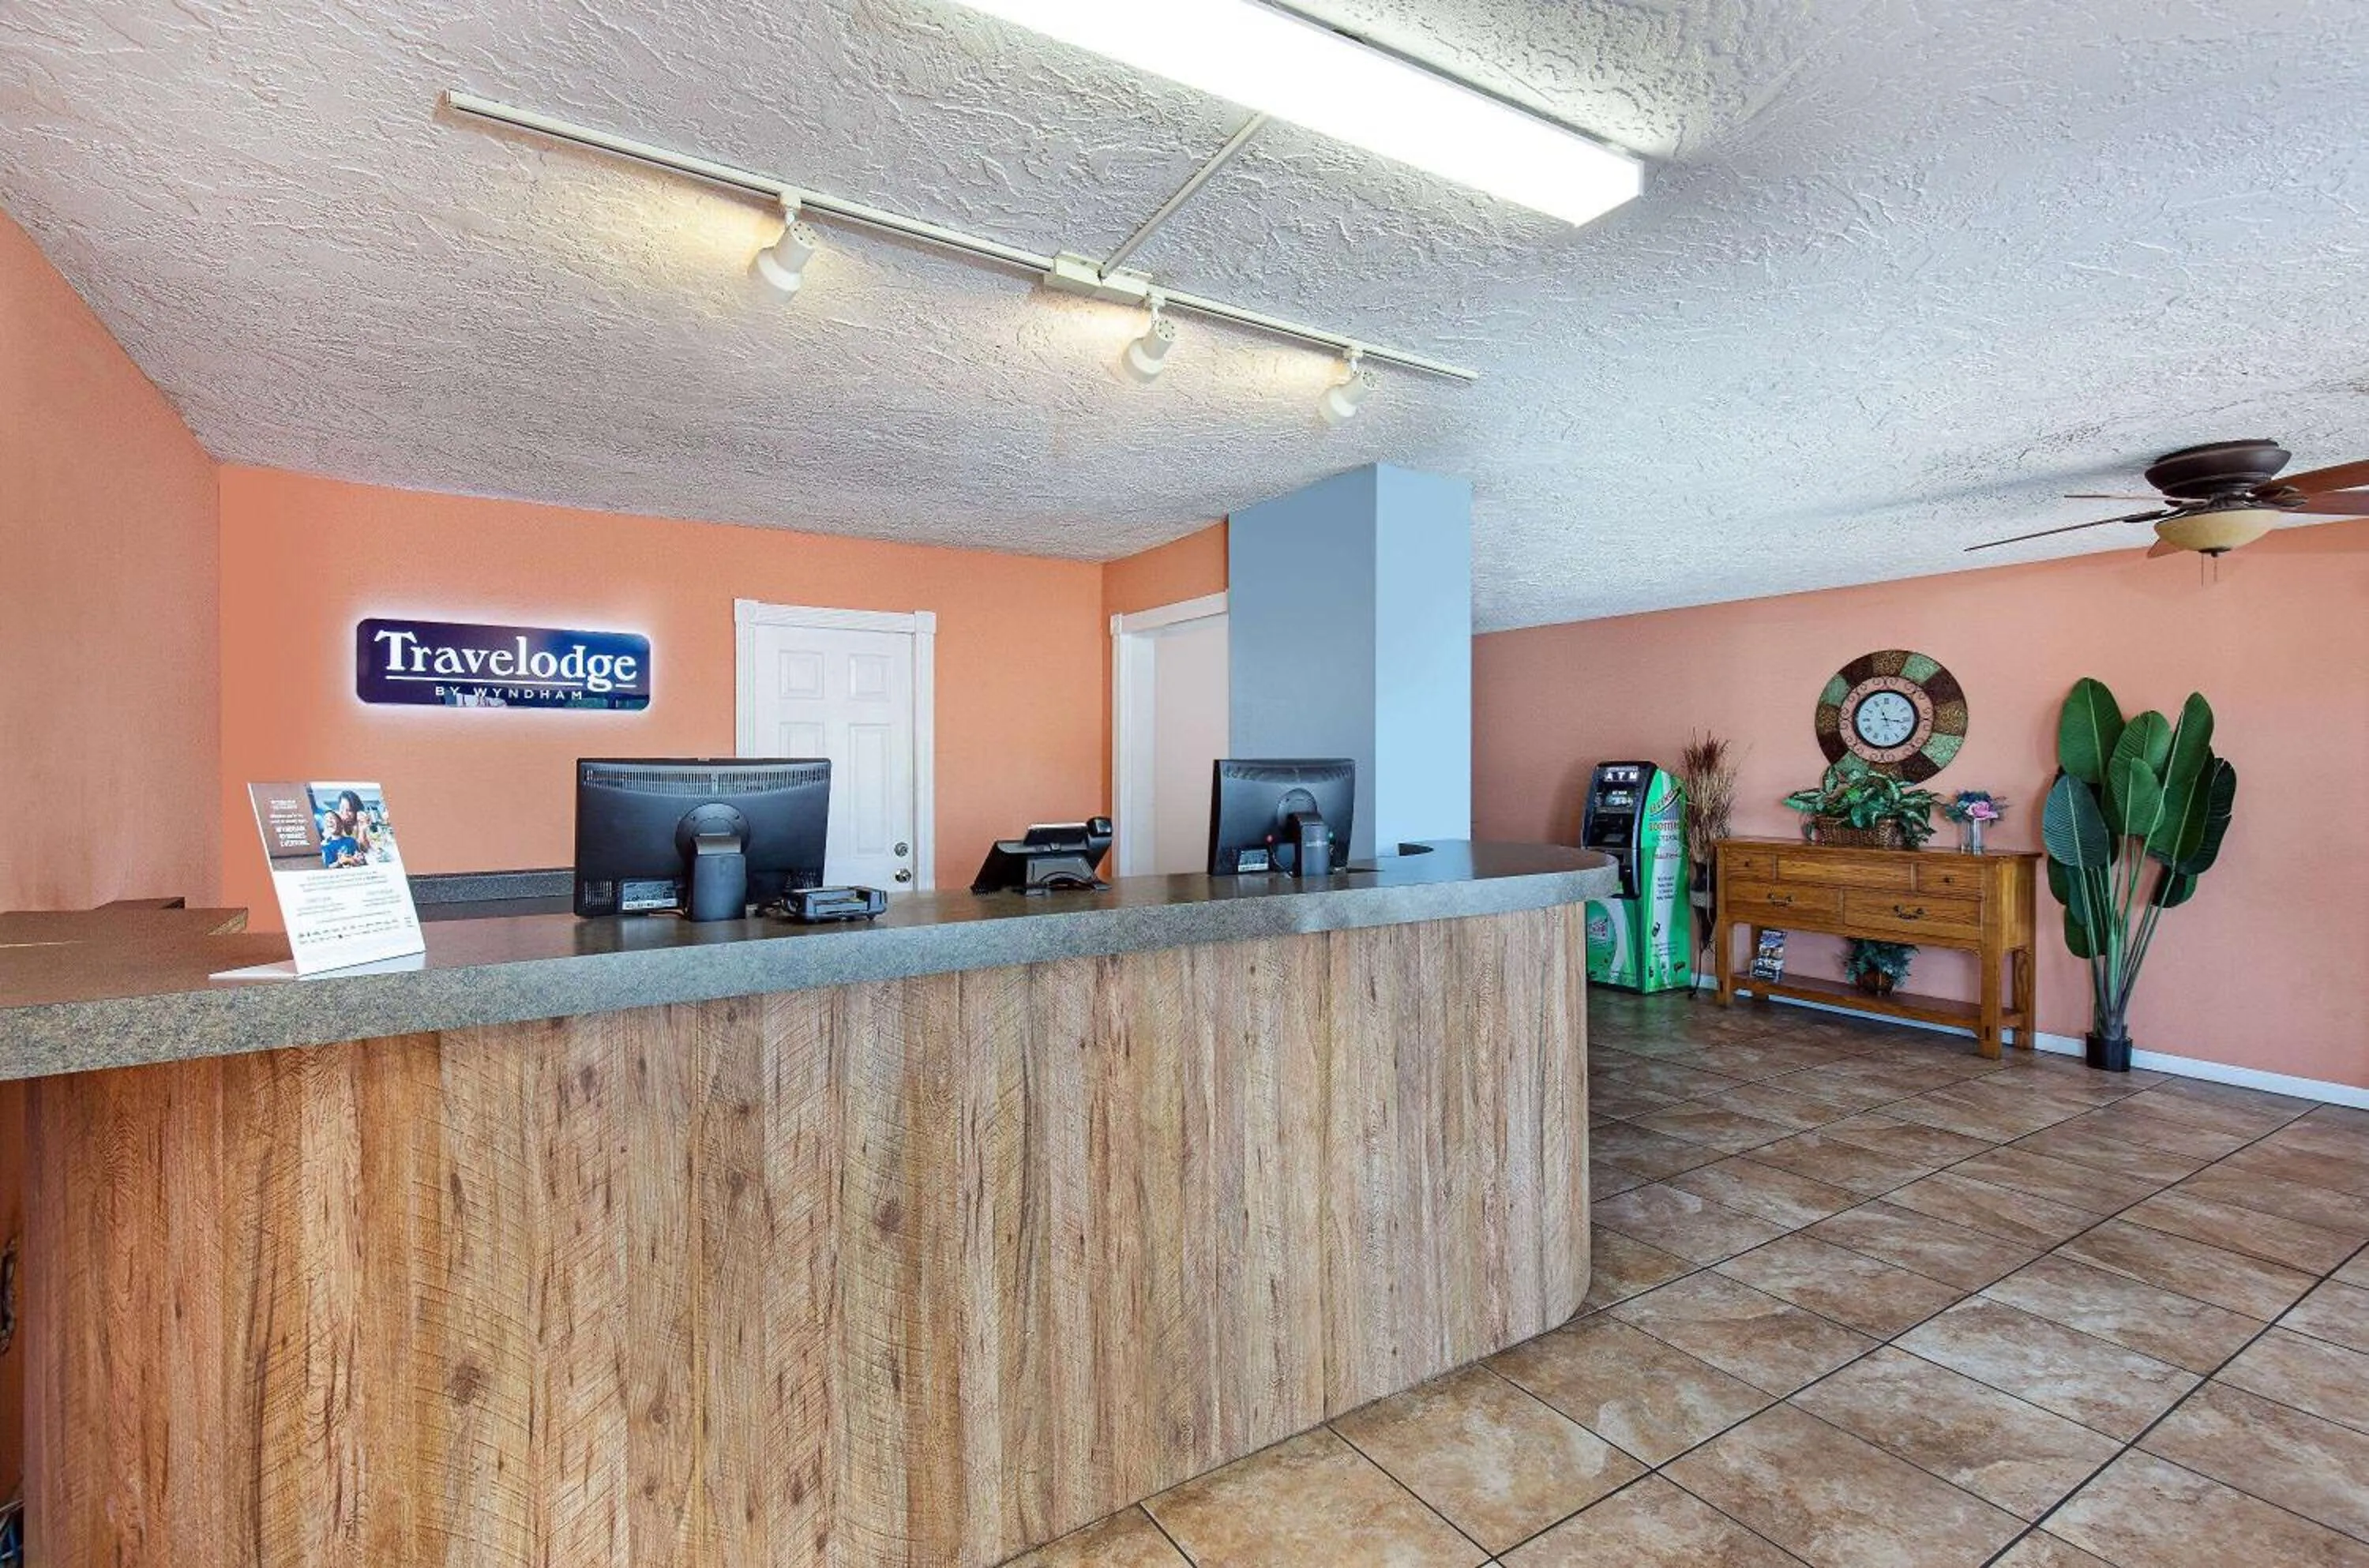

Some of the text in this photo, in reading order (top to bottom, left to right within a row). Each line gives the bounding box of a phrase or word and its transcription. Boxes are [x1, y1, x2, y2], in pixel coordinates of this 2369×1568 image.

[374, 629, 637, 692] Travelodge
[435, 685, 583, 700] BY WYNDHAM
